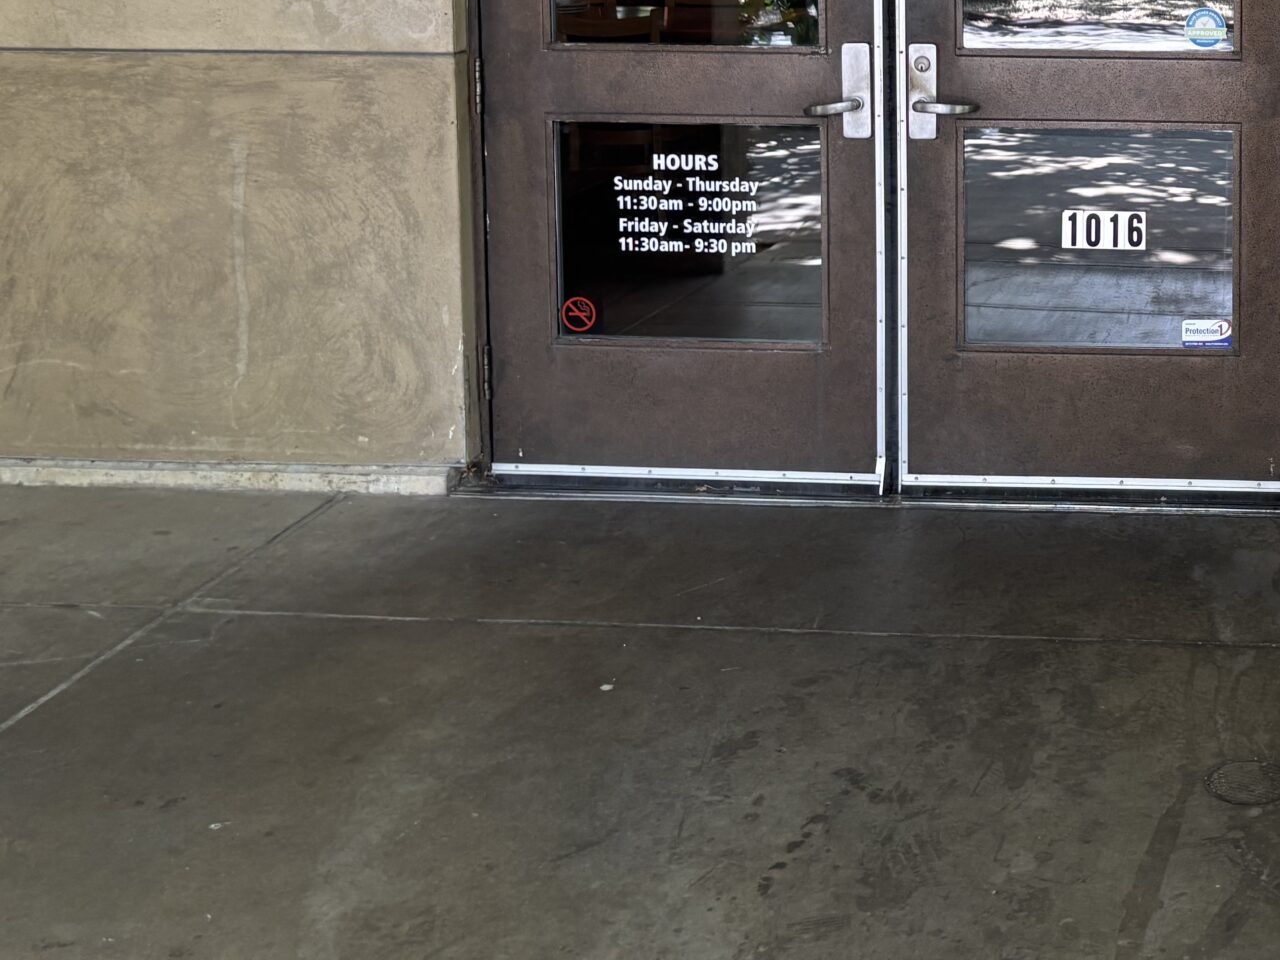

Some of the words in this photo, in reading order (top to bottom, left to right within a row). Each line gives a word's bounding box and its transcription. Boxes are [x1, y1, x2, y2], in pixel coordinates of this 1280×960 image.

[652, 153, 719, 171] HOURS
[613, 176, 672, 194] Sunday
[686, 176, 759, 195] Thursday
[616, 195, 683, 211] 11:30am
[698, 197, 757, 214] 9:00pm
[618, 217, 669, 237] Friday
[683, 218, 756, 238] Saturday
[1068, 212, 1143, 248] 1016
[694, 238, 728, 253] 9:30
[731, 242, 757, 257] pm
[1184, 327, 1219, 335] Protection
